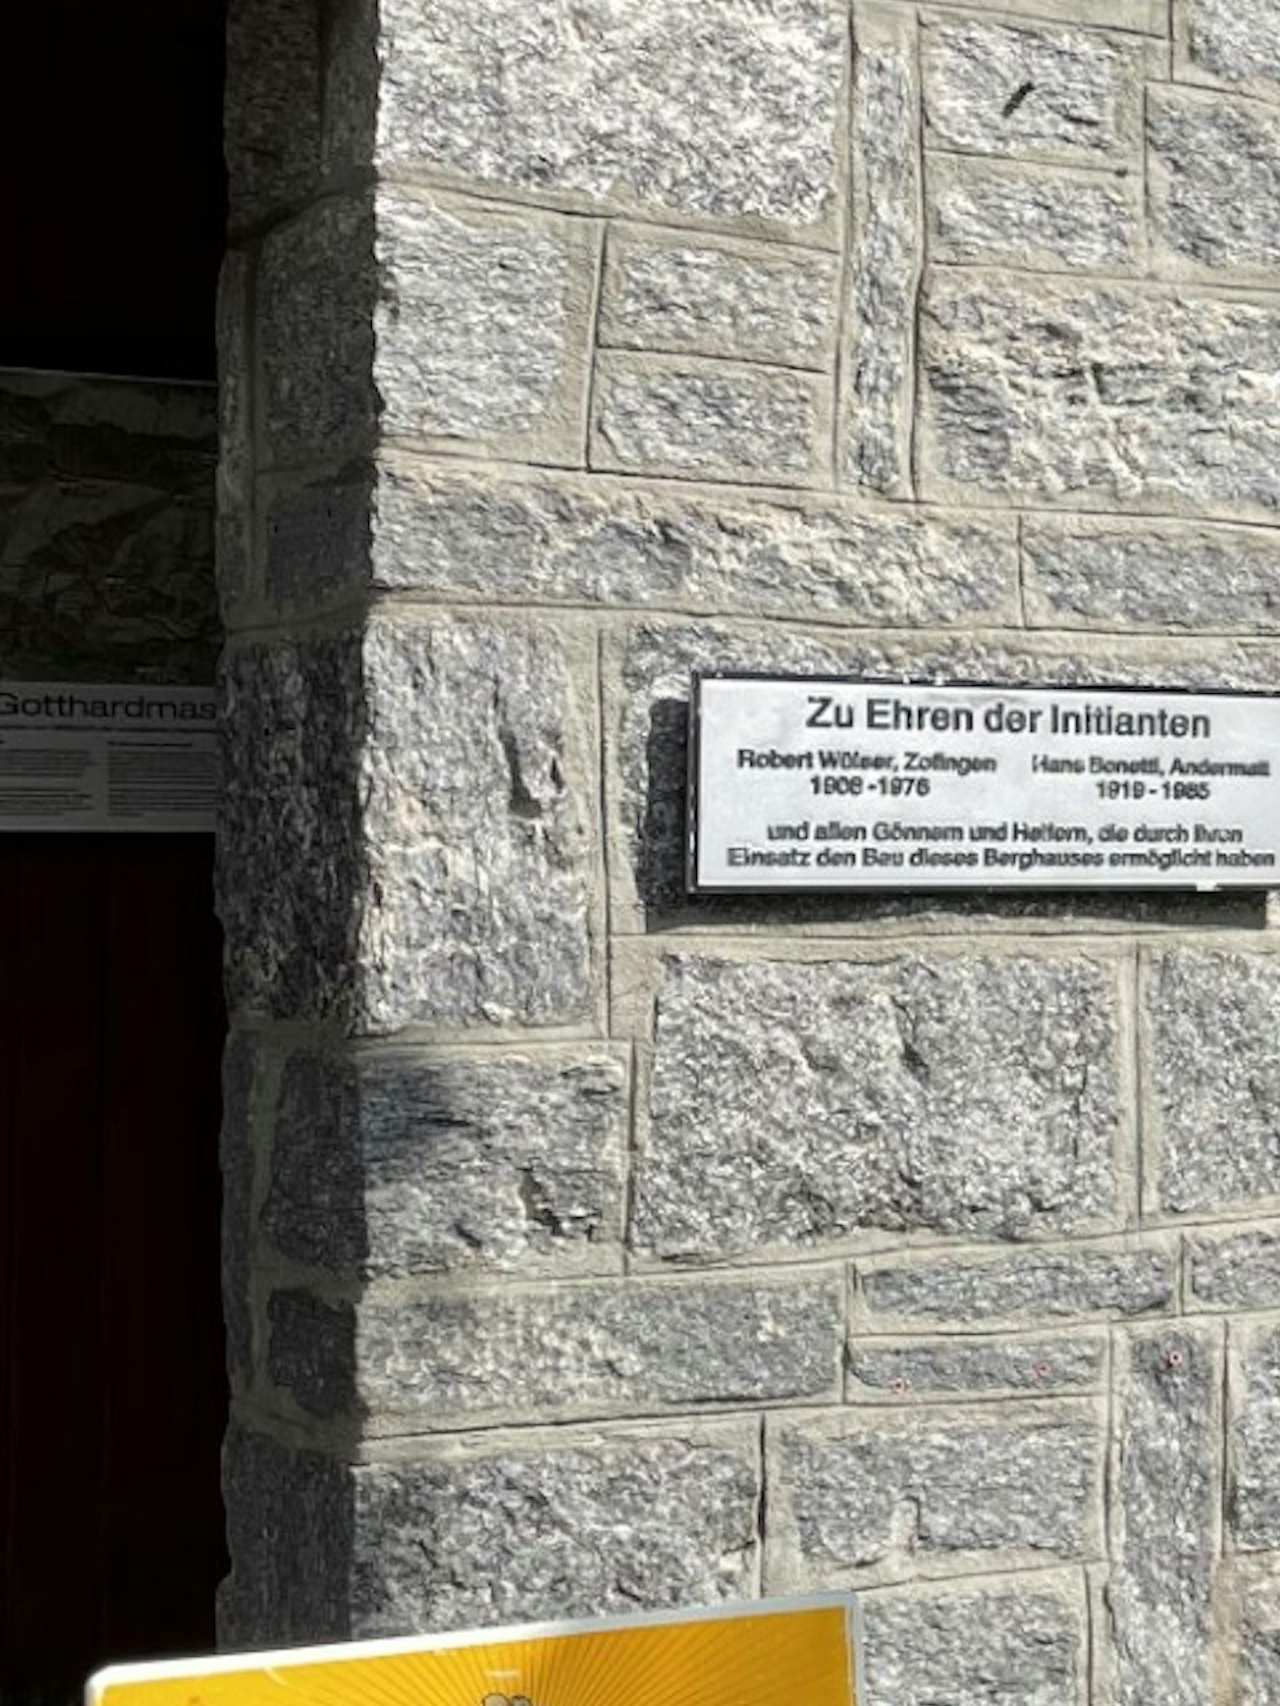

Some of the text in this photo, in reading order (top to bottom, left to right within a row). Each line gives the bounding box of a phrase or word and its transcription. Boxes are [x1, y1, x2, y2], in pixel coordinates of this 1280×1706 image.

[805, 696, 1211, 738] Zu Ehren der Initianten
[737, 749, 813, 769] Robert
[904, 752, 997, 775] Zofingen
[1032, 754, 1085, 773] Hans
[1170, 757, 1271, 776] Andermatt
[767, 821, 809, 841] und
[814, 822, 867, 841] allen
[968, 822, 1007, 841] und
[1098, 823, 1129, 842] die
[1134, 822, 1189, 842] durch
[727, 846, 811, 867] Einsatz
[816, 847, 856, 867] den
[909, 847, 978, 867] dieses
[983, 848, 1104, 872] Berghauses
[1109, 849, 1212, 872] ermöglicht
[1216, 849, 1276, 867] haben
